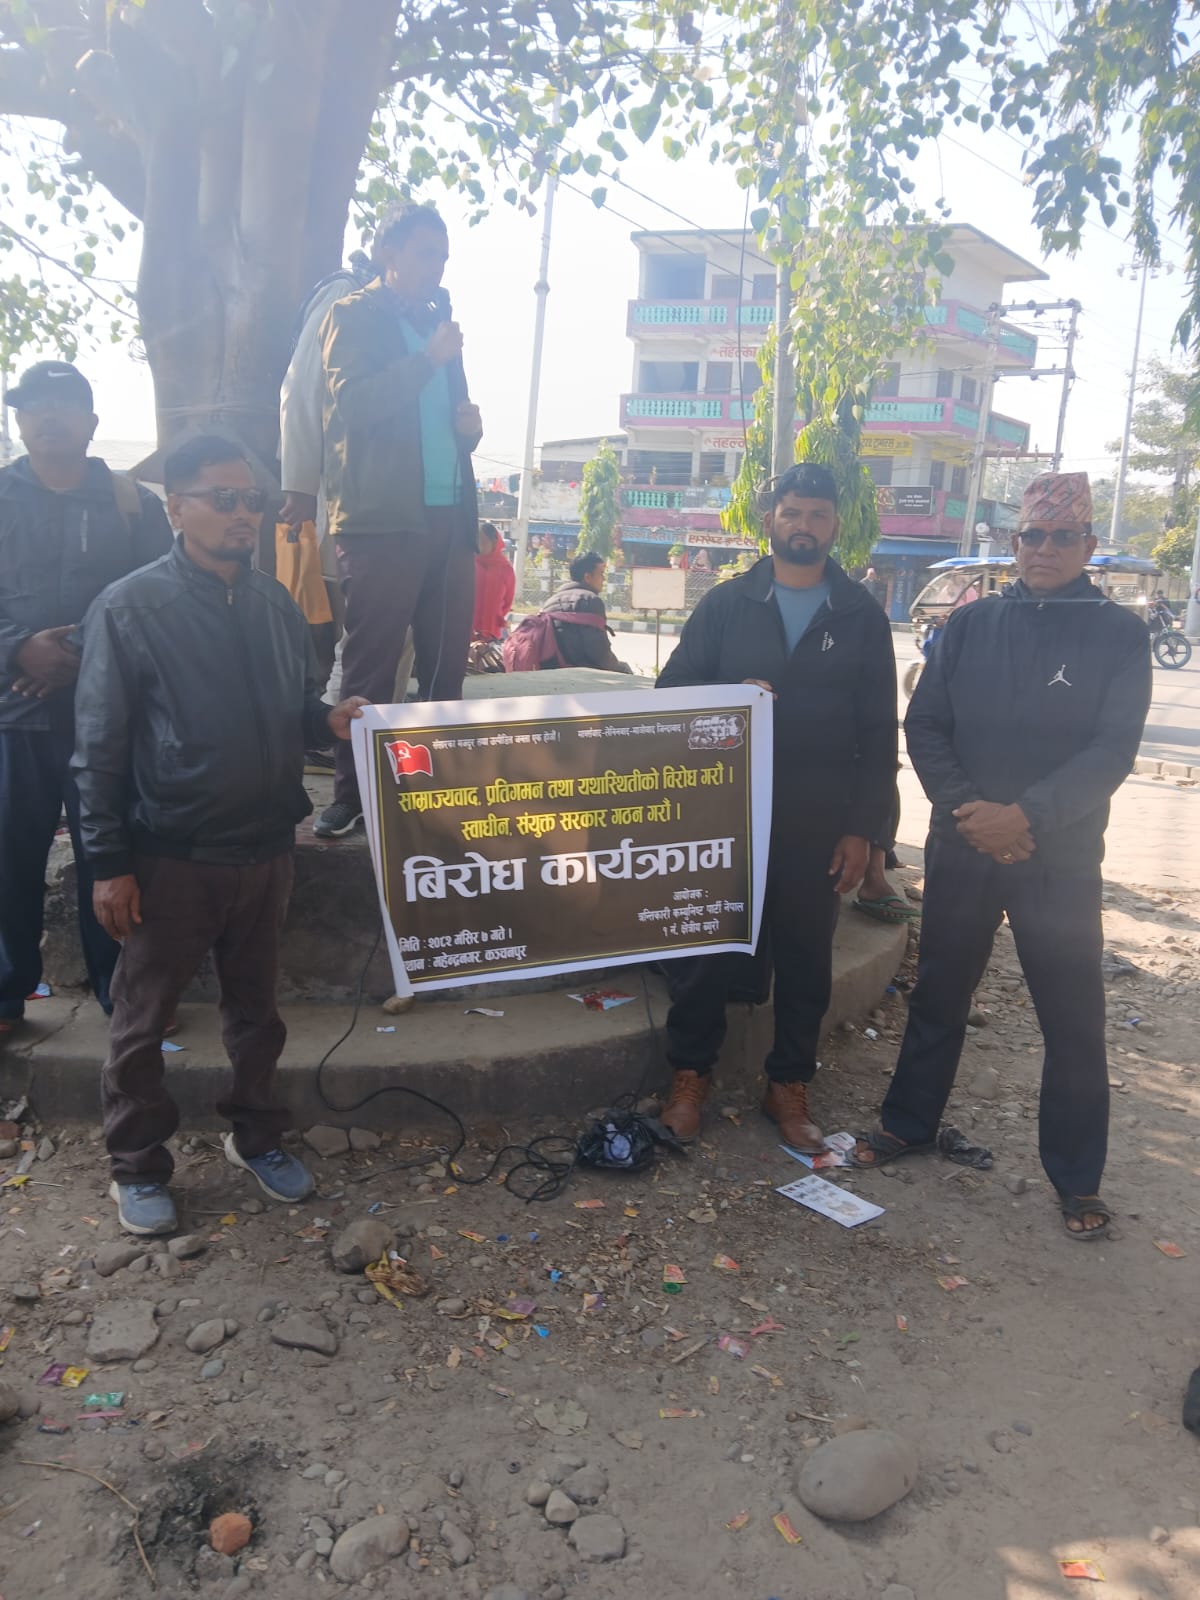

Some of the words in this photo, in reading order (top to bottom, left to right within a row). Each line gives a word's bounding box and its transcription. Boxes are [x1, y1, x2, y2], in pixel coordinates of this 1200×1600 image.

[485, 778, 545, 806] प्रतिगमन
[547, 779, 575, 800] तथा
[577, 766, 660, 796] यथास्थितीको
[515, 811, 557, 838] संयुक्त
[558, 808, 609, 832] सरकार
[610, 806, 644, 825] गठन
[402, 851, 528, 903] बिरोध
[673, 887, 704, 902] आयोजक
[722, 899, 745, 914] नेपाल
[398, 934, 421, 953] मिति
